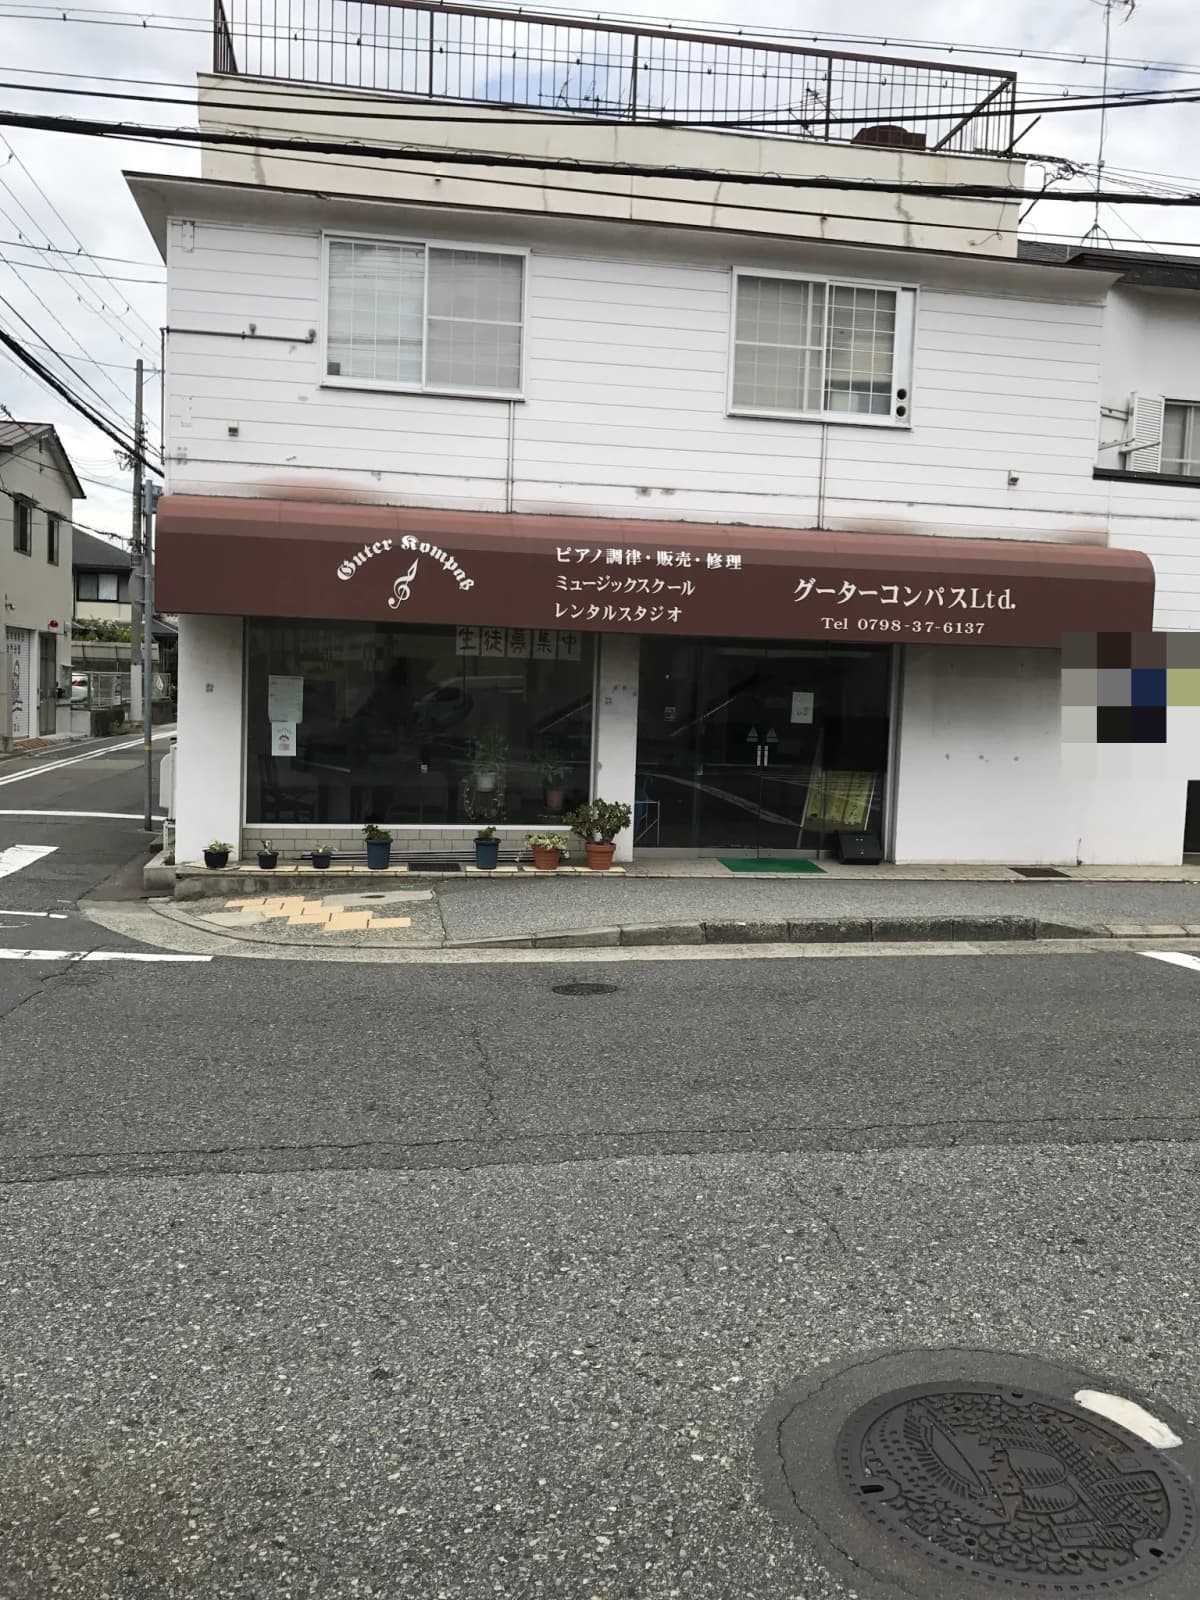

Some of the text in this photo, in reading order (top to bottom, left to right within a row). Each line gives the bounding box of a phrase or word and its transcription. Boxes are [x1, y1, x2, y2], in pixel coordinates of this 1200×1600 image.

[337, 538, 393, 581] Guter
[555, 546, 742, 570] ピアノ調律・販売・修理
[556, 575, 696, 596] ミュージックスクール
[793, 577, 1016, 610] グーターコンパスLtd.
[555, 602, 683, 623] レンタルスタジオ
[821, 616, 985, 635] Tel 0798-37-6137
